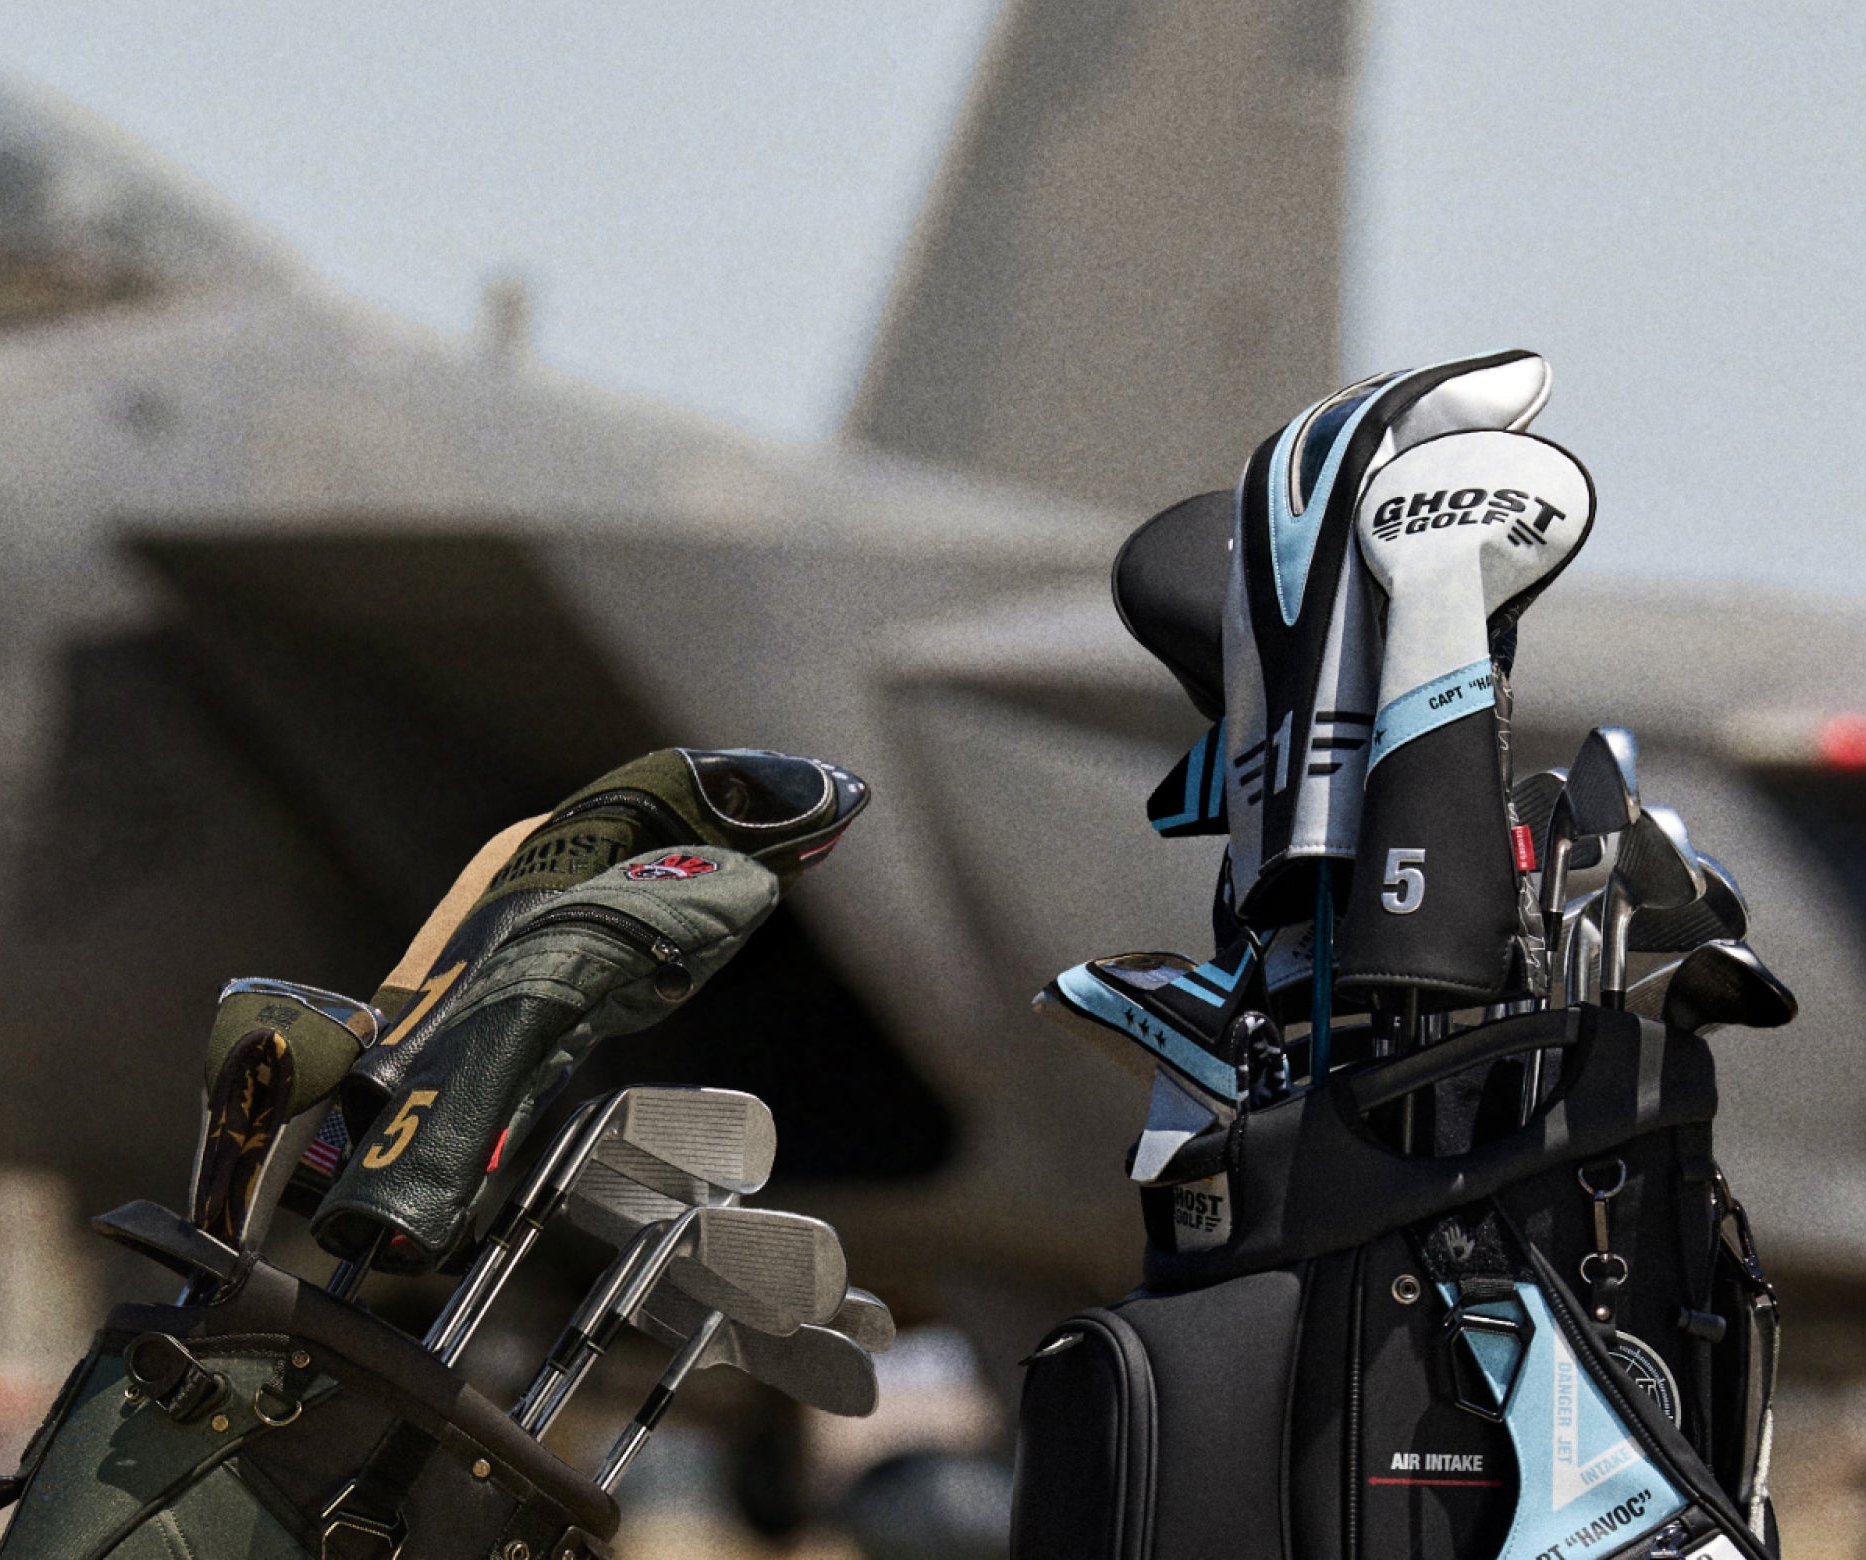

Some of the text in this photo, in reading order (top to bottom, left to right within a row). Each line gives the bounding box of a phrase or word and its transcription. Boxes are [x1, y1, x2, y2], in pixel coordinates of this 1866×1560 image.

[1373, 488, 1567, 533] GHOST
[1405, 510, 1509, 534] GOLF
[1429, 685, 1463, 710] CAPT
[1273, 710, 1293, 795] 1
[1381, 847, 1426, 914] 5
[380, 961, 468, 1045] 1
[362, 1090, 438, 1168] 5
[1174, 1186, 1223, 1216] HOST
[1557, 1362, 1573, 1463] DANGER JET
[1390, 1452, 1484, 1471] AIR INTAKE
[1579, 1447, 1633, 1486] INTAKE
